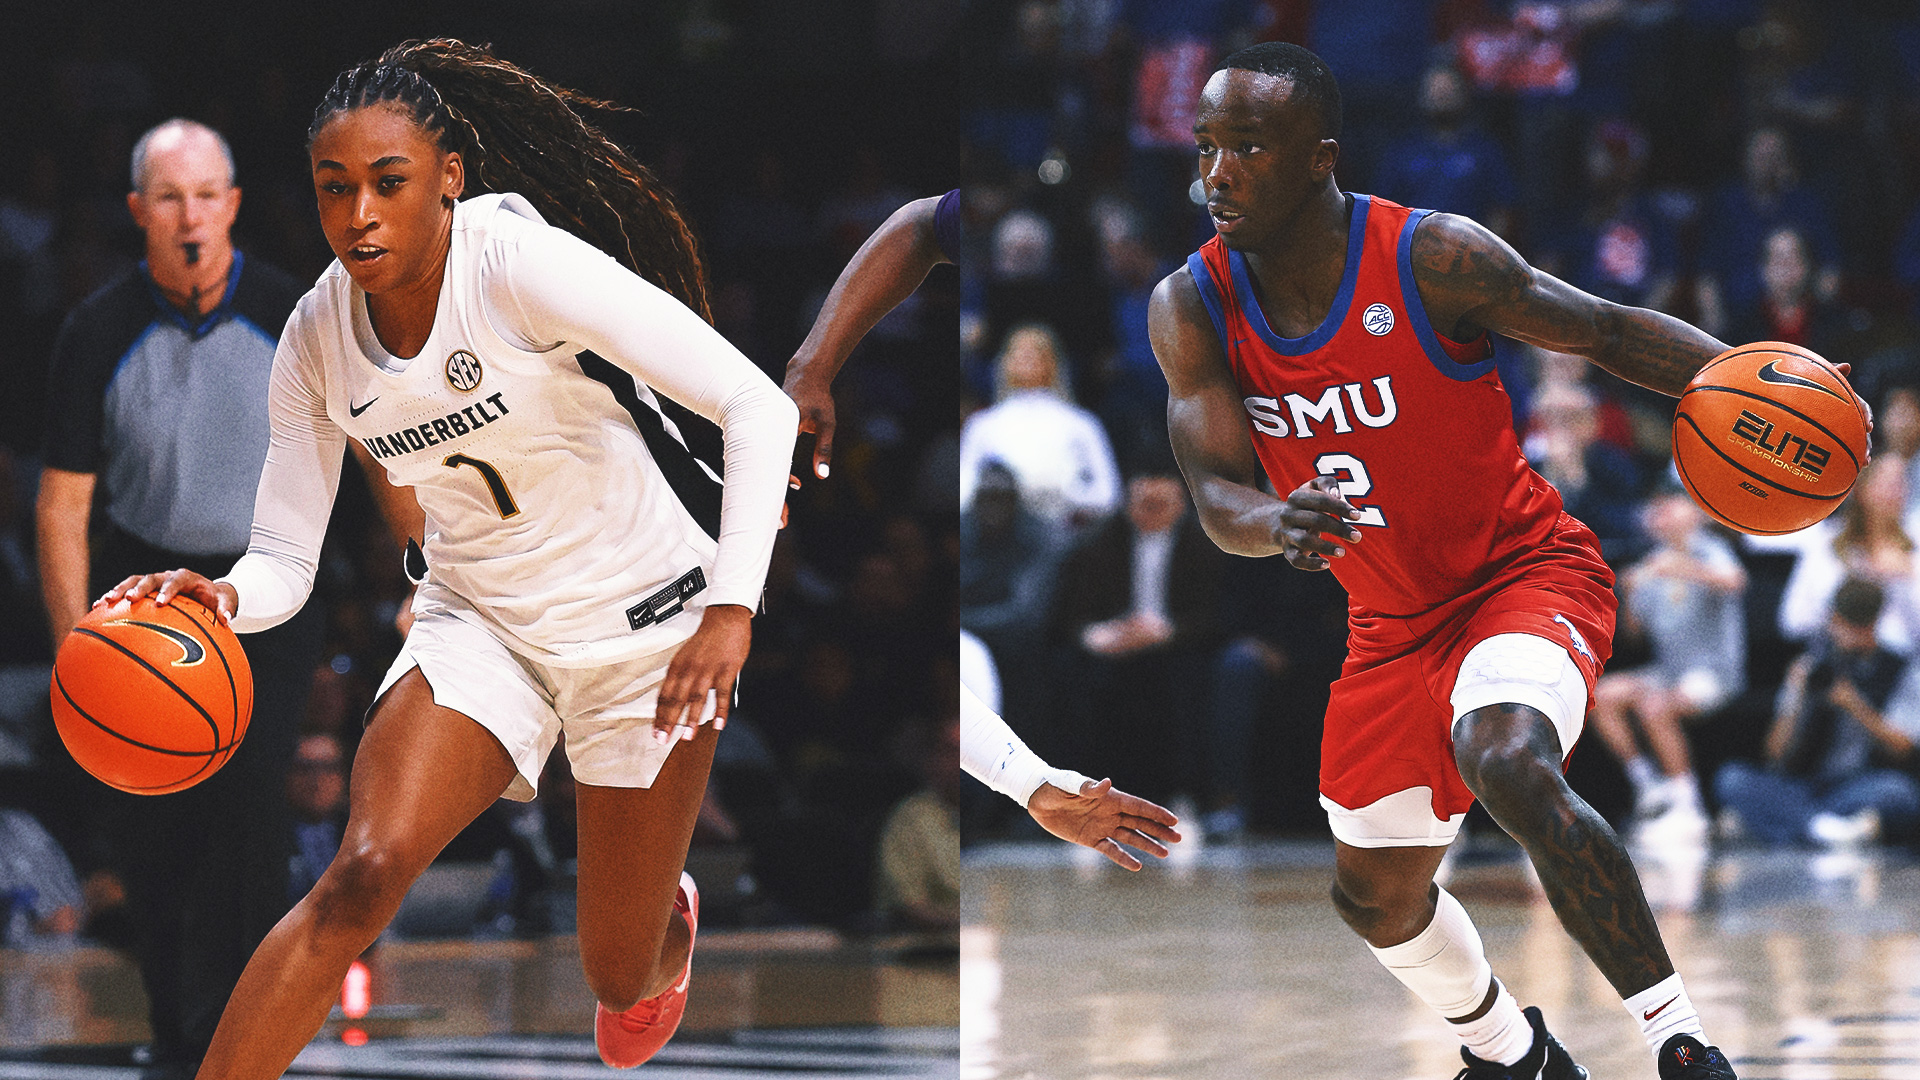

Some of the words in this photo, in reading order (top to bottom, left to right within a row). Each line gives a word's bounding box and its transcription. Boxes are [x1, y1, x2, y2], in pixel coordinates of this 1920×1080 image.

[447, 351, 481, 390] SEC
[363, 391, 510, 459] VANDERBILT
[1243, 374, 1399, 438] SMU
[441, 452, 521, 520] 1
[1311, 451, 1390, 528] 2
[1727, 434, 1819, 483] CHAMPIONSHIP
[683, 579, 694, 593] 44
